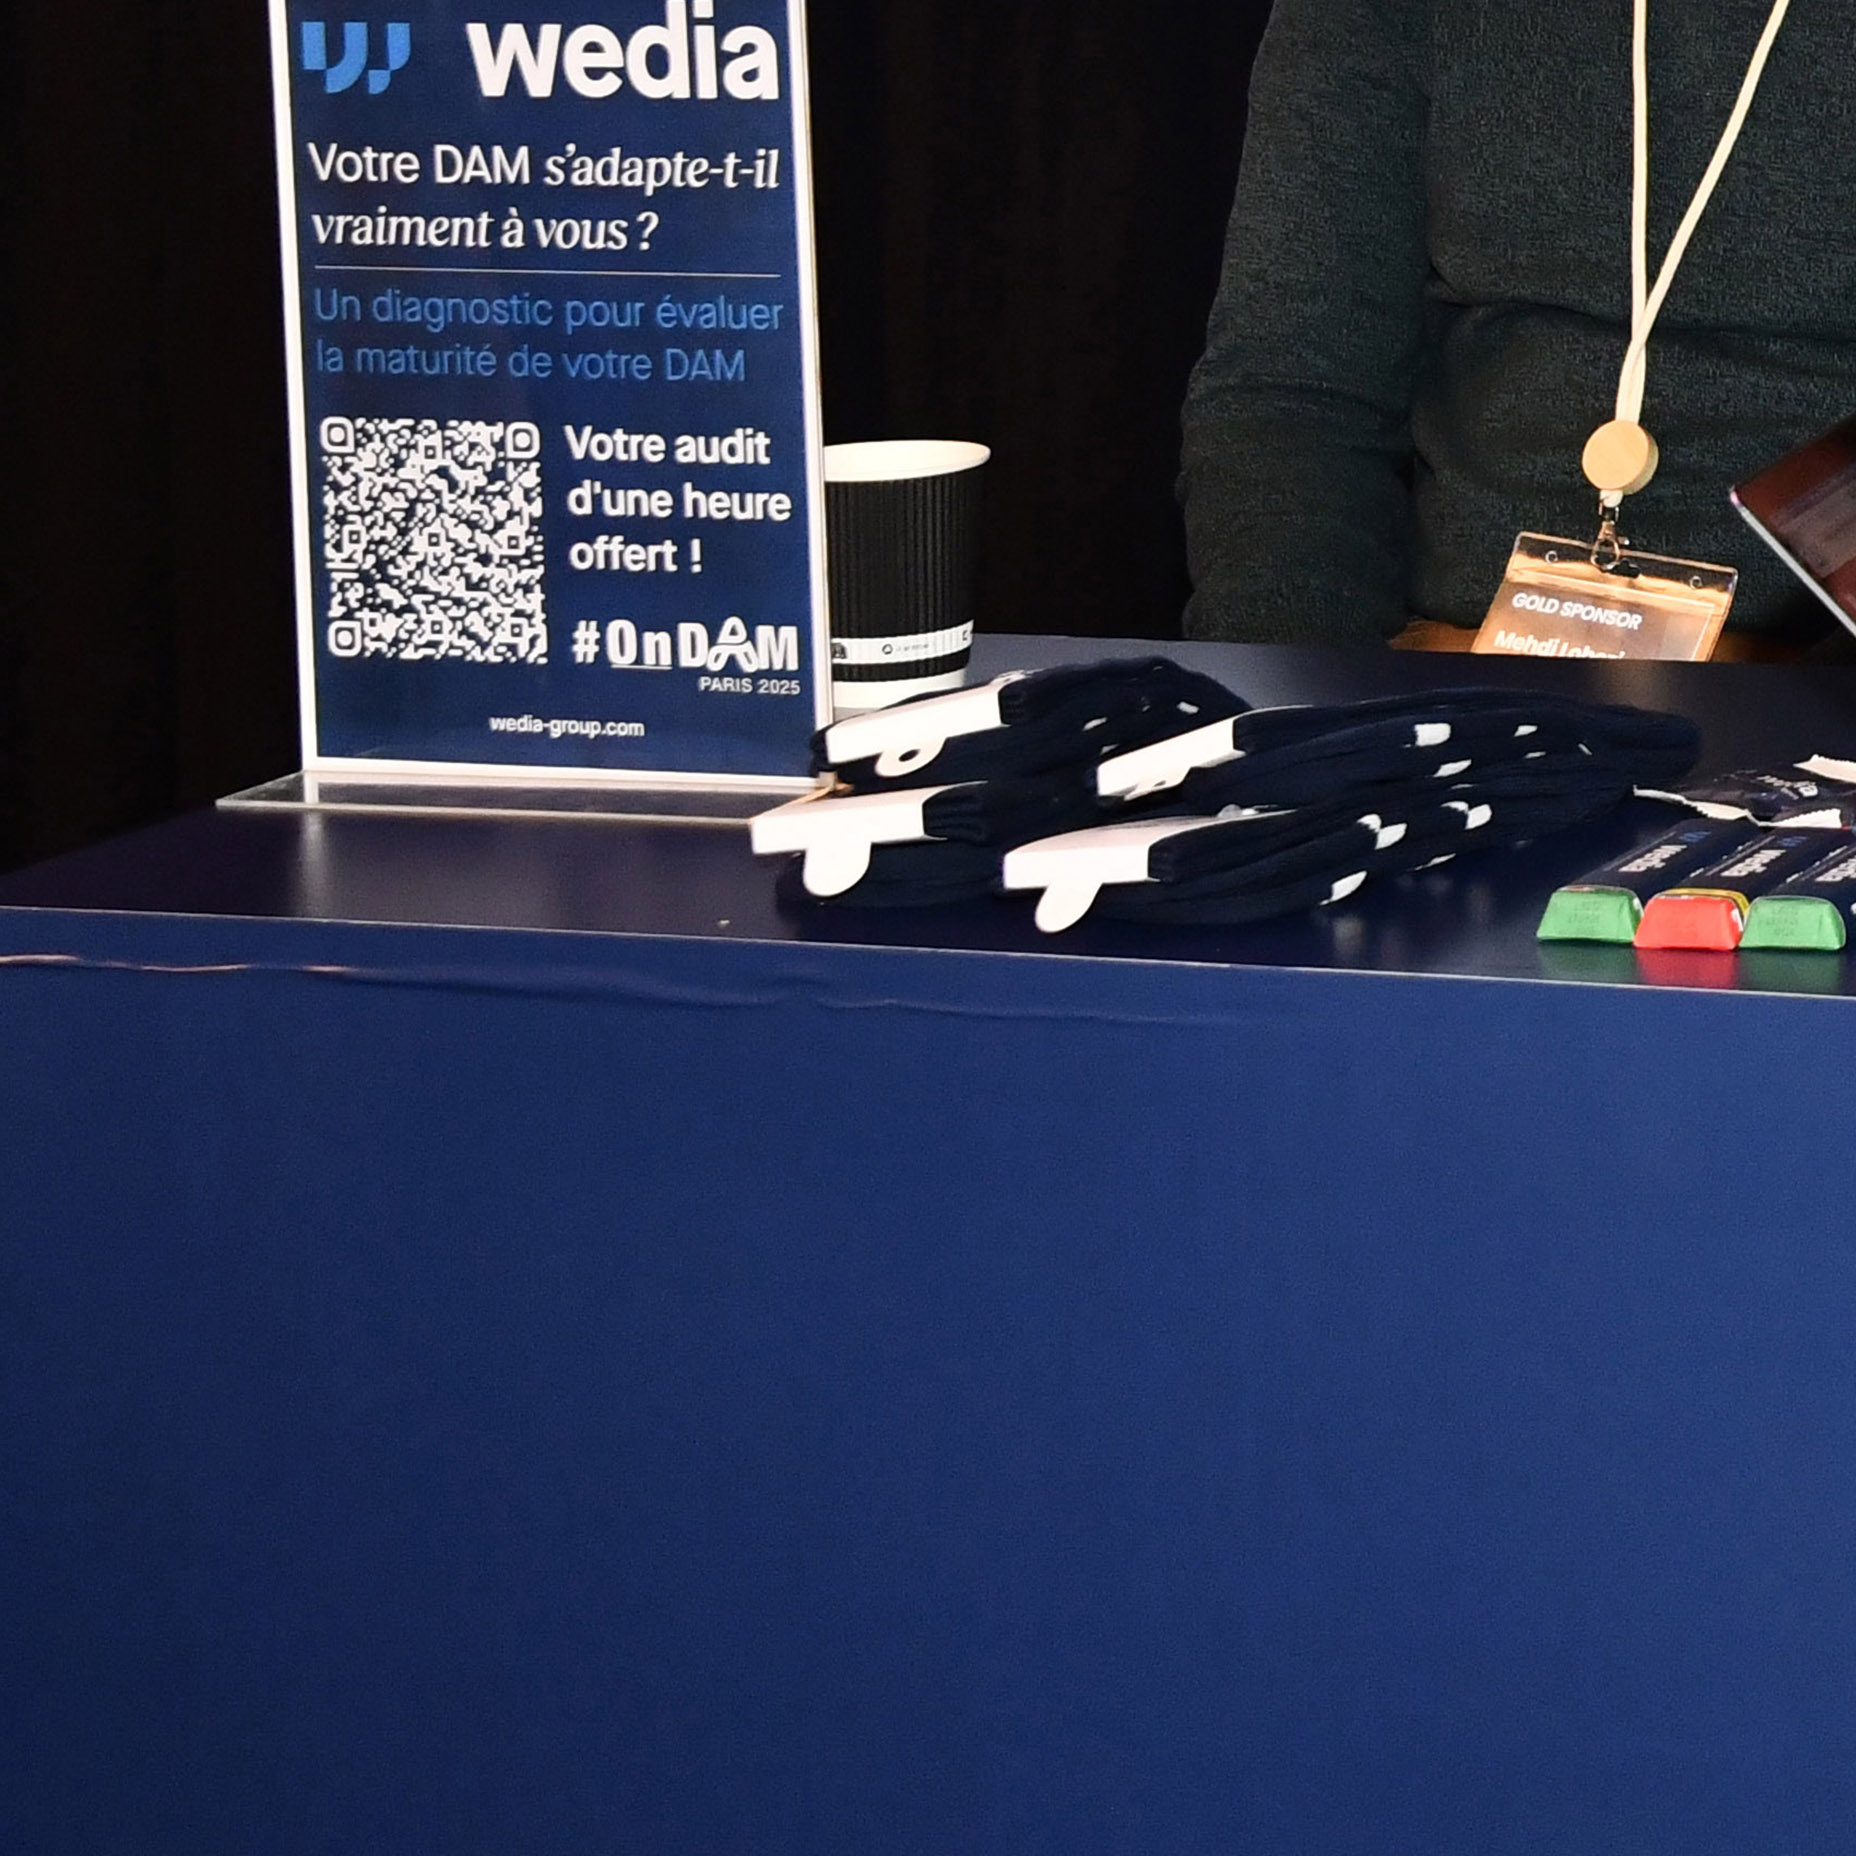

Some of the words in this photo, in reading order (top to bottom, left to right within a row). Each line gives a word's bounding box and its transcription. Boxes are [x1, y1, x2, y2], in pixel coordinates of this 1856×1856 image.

[307, 143, 419, 183] Votre
[434, 145, 529, 184] DAM
[543, 144, 779, 196] s'adapte-t-il
[312, 206, 494, 247] vraiment
[501, 207, 524, 247] à
[534, 219, 628, 249] vous
[637, 212, 658, 250] ?
[314, 288, 360, 320] Un
[372, 289, 552, 332] diagnostic
[565, 301, 645, 334] pour
[655, 295, 784, 330] évaluer
[316, 339, 343, 373] la
[356, 343, 496, 376] maturité
[508, 344, 552, 378] de
[563, 350, 652, 380] votre
[665, 348, 744, 381] DAM
[565, 425, 665, 462] Votre
[675, 428, 770, 464] audit
[567, 479, 673, 517] d'une
[683, 482, 791, 521] heure
[569, 535, 677, 571] offert
[691, 539, 701, 573] !
[1512, 593, 1559, 613] GOLD
[1561, 602, 1642, 630] SPONSOR
[1494, 630, 1560, 656] Mehdi
[699, 677, 752, 693] PARIS
[757, 679, 800, 694] 2025
[490, 715, 644, 738] wedia-group.com
